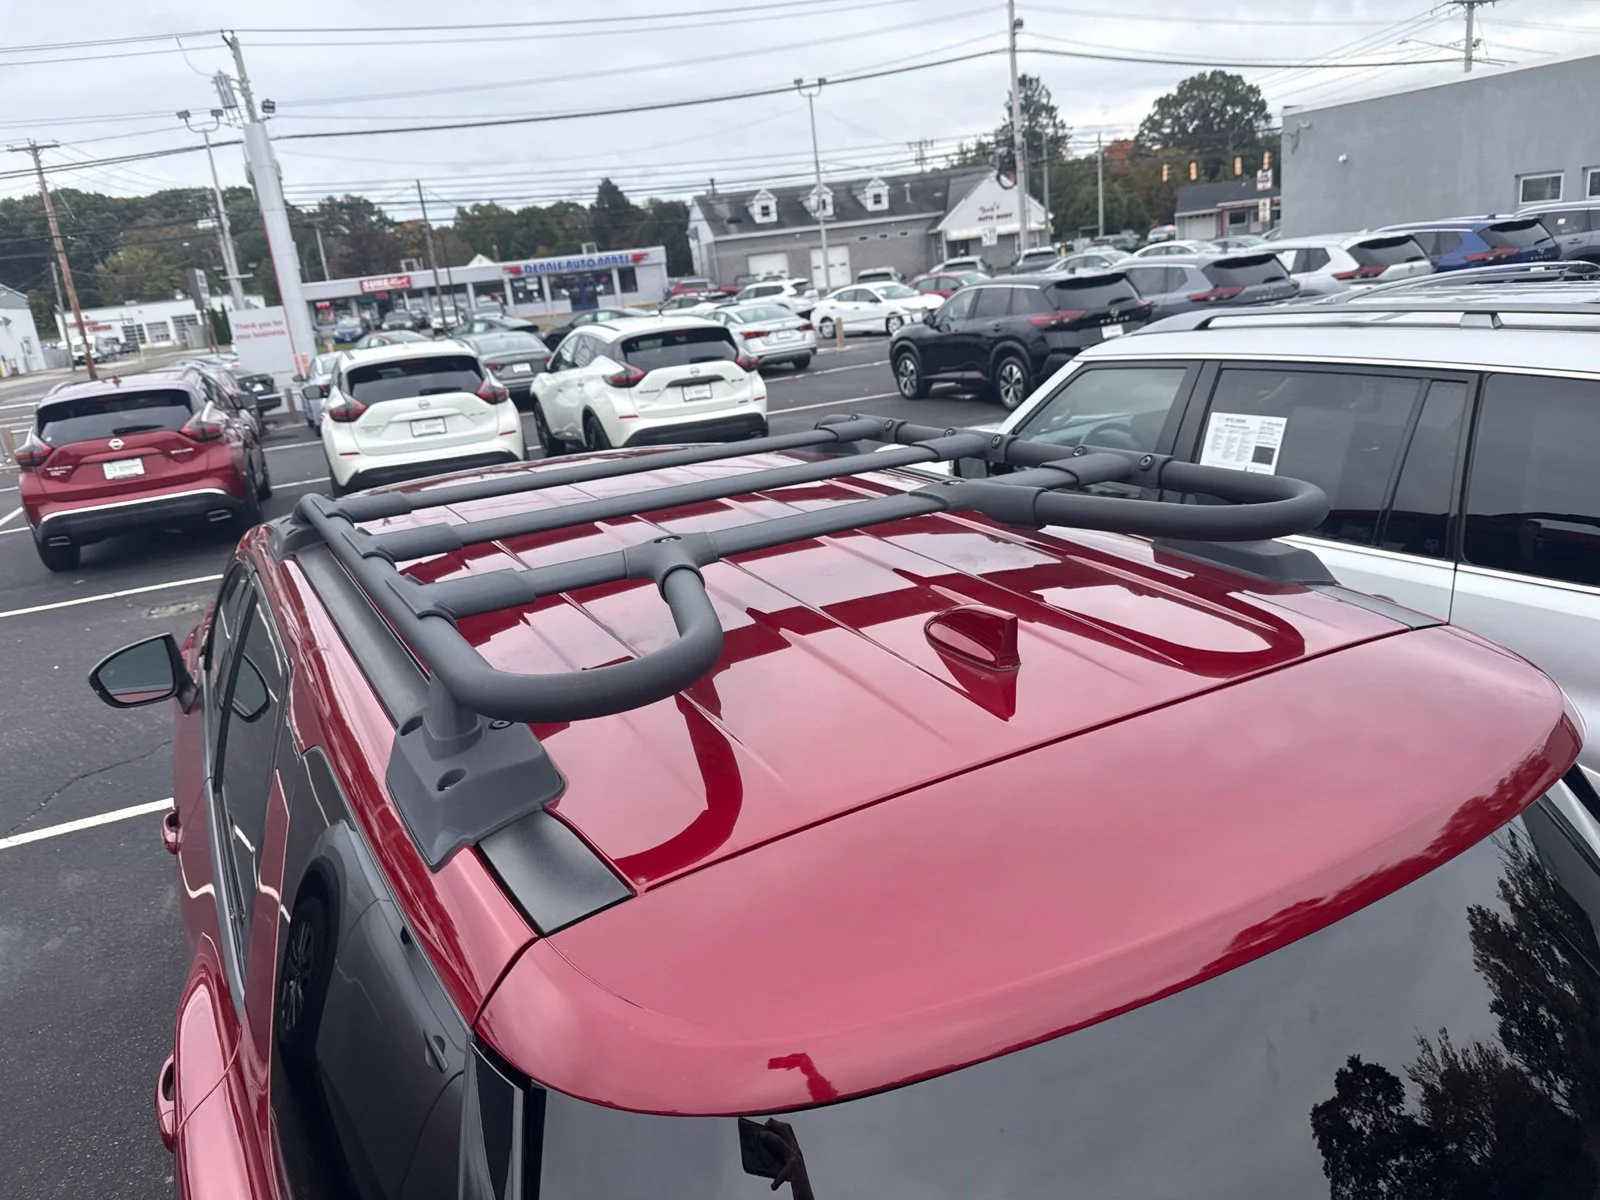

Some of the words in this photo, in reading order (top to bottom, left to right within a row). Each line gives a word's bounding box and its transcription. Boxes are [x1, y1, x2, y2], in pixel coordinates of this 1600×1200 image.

[524, 261, 563, 274] DENNIS
[565, 258, 597, 270] AUTO
[597, 254, 630, 266] PARTS
[258, 322, 272, 330] you
